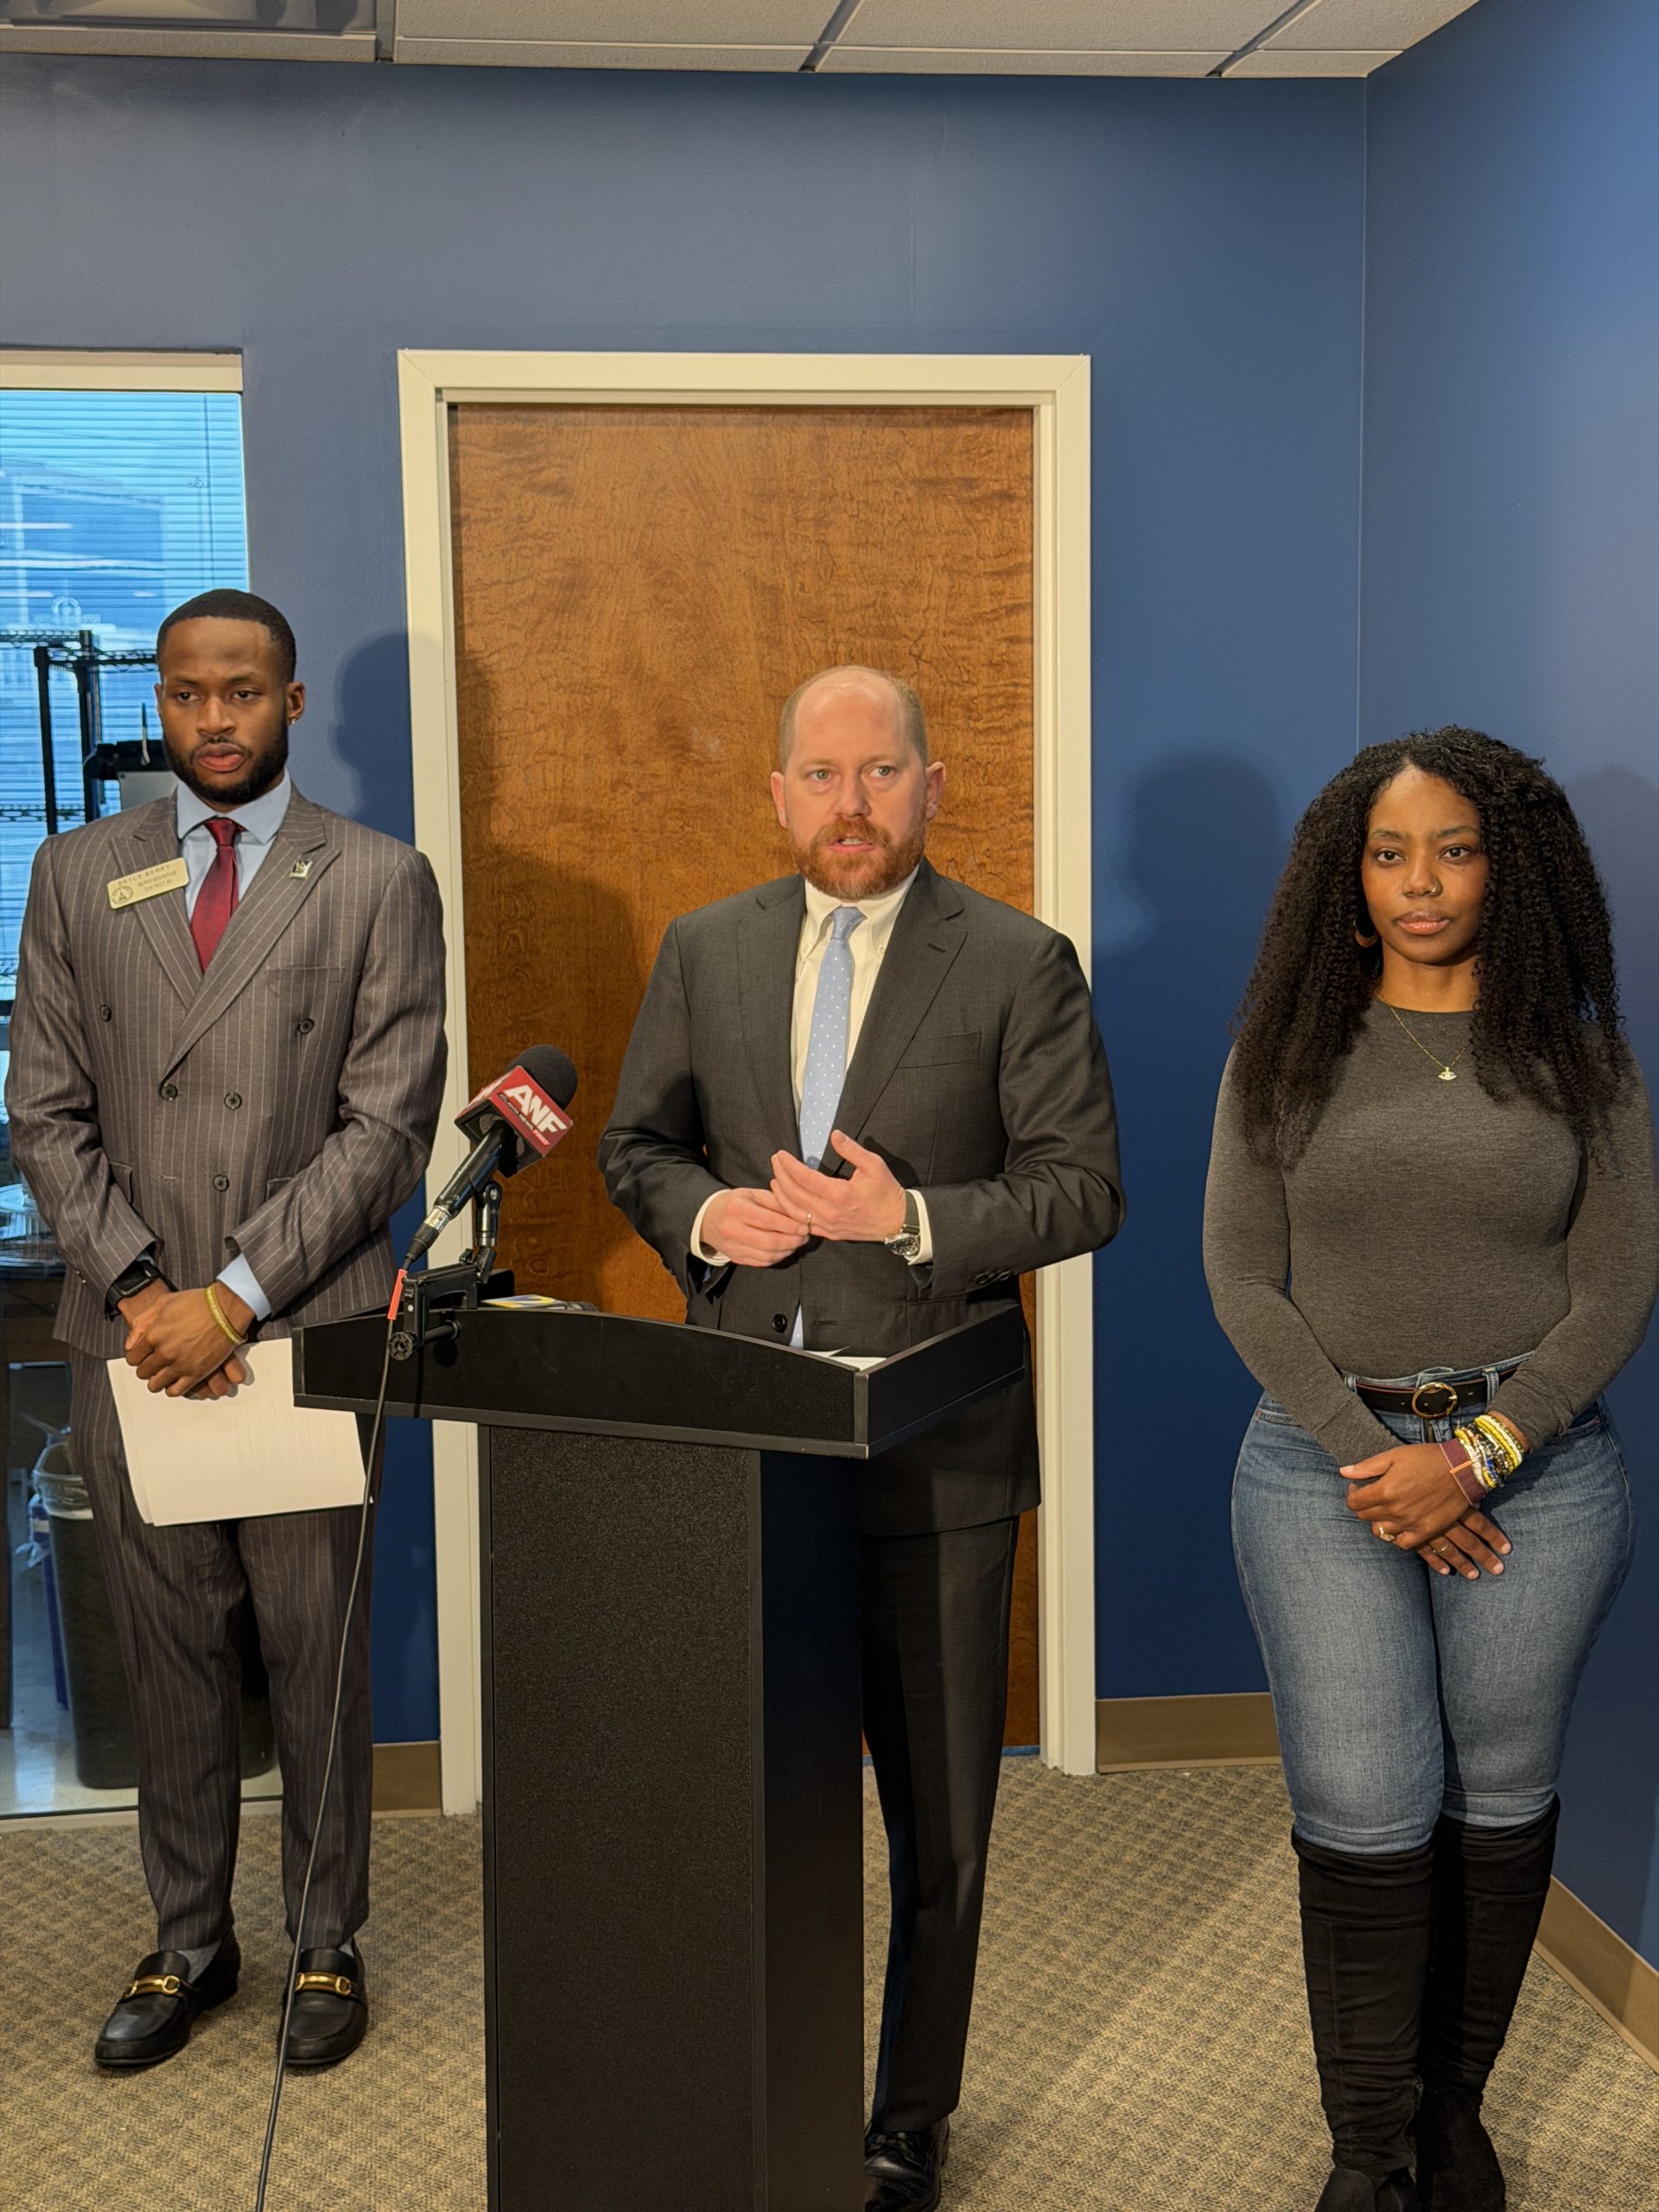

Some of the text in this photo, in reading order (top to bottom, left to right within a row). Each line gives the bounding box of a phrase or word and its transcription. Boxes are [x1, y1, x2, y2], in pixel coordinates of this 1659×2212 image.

[118, 865, 169, 886] BRYCE BERRY
[499, 1093, 519, 1116] ATLANTA
[518, 1114, 534, 1130] NEWS
[504, 1084, 567, 1133] ANF
